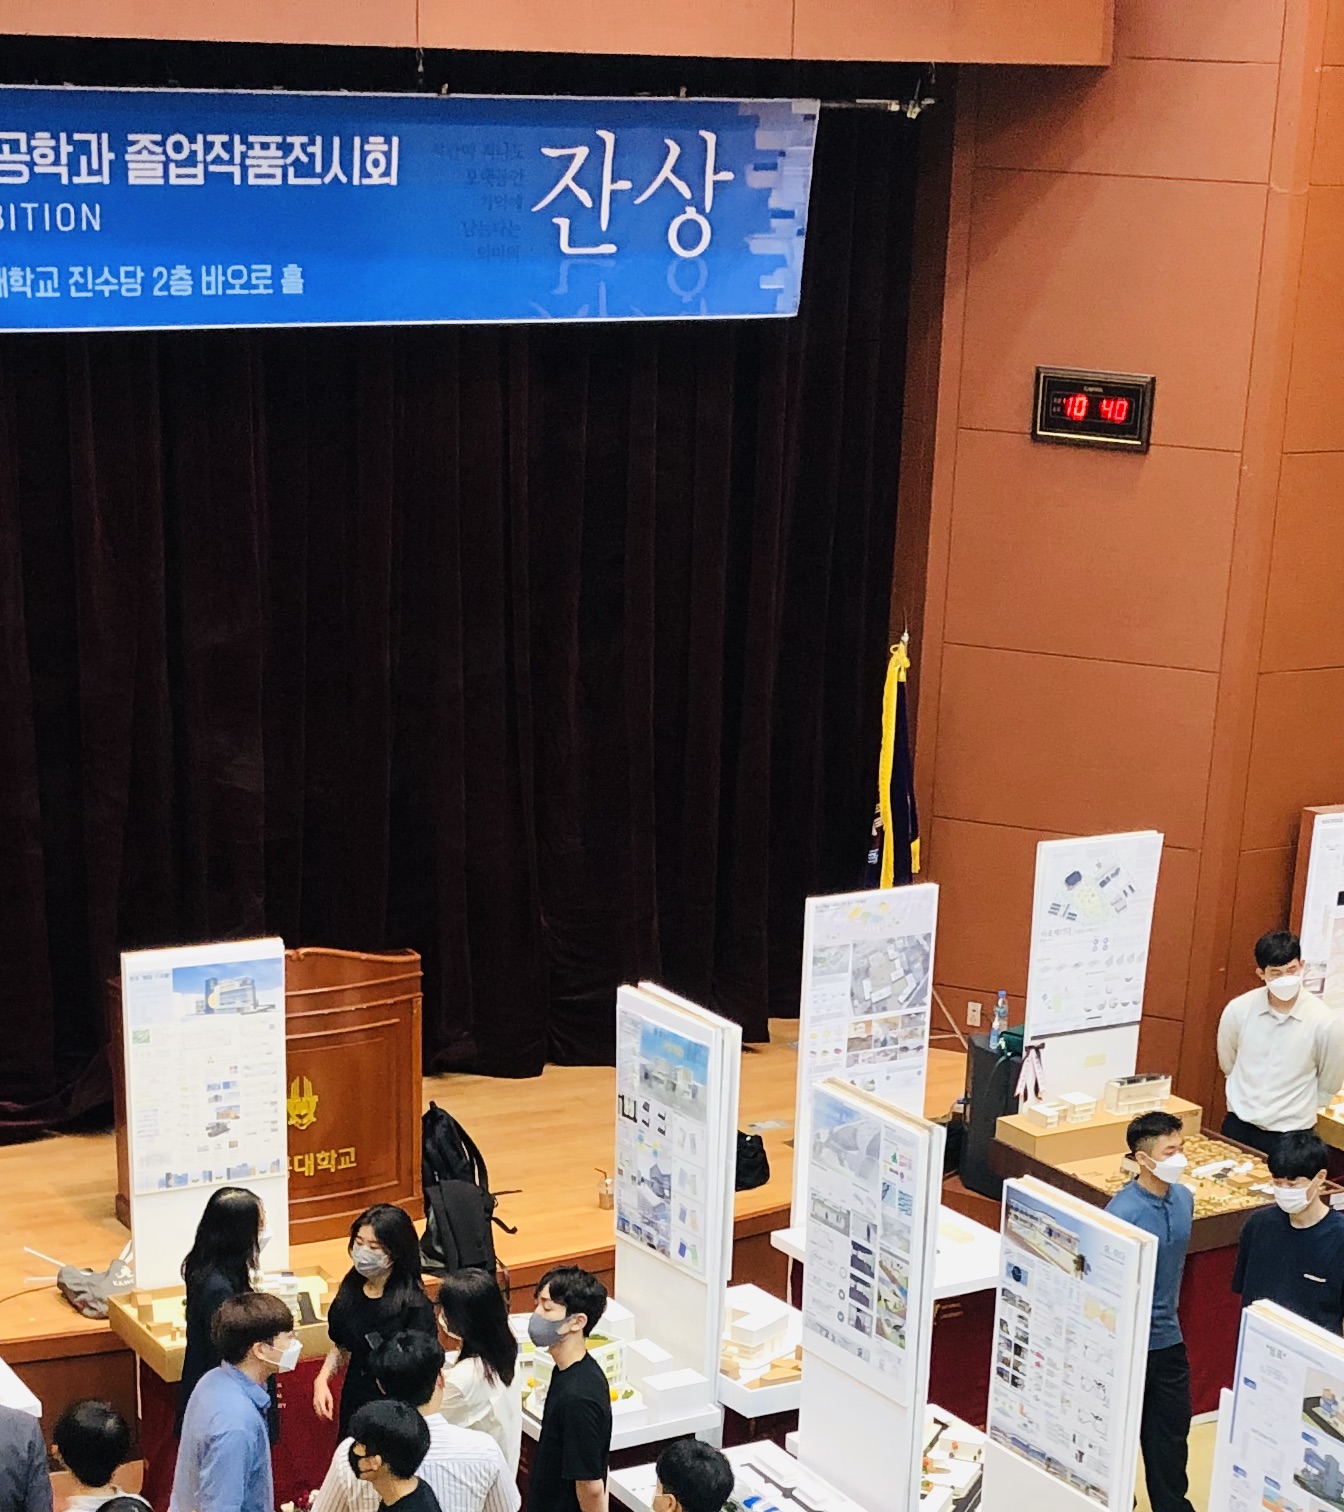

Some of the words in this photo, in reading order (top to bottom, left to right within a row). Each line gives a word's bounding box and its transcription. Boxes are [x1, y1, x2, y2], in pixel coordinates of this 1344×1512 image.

[125, 133, 400, 187] 졸업작품전시회
[530, 128, 736, 258] 잔상
[68, 266, 144, 298] 진수당
[152, 267, 194, 297] 2층
[201, 265, 274, 296] 바오로
[281, 265, 305, 295] 홀
[1064, 395, 1089, 419] 10
[1102, 398, 1128, 421] 40
